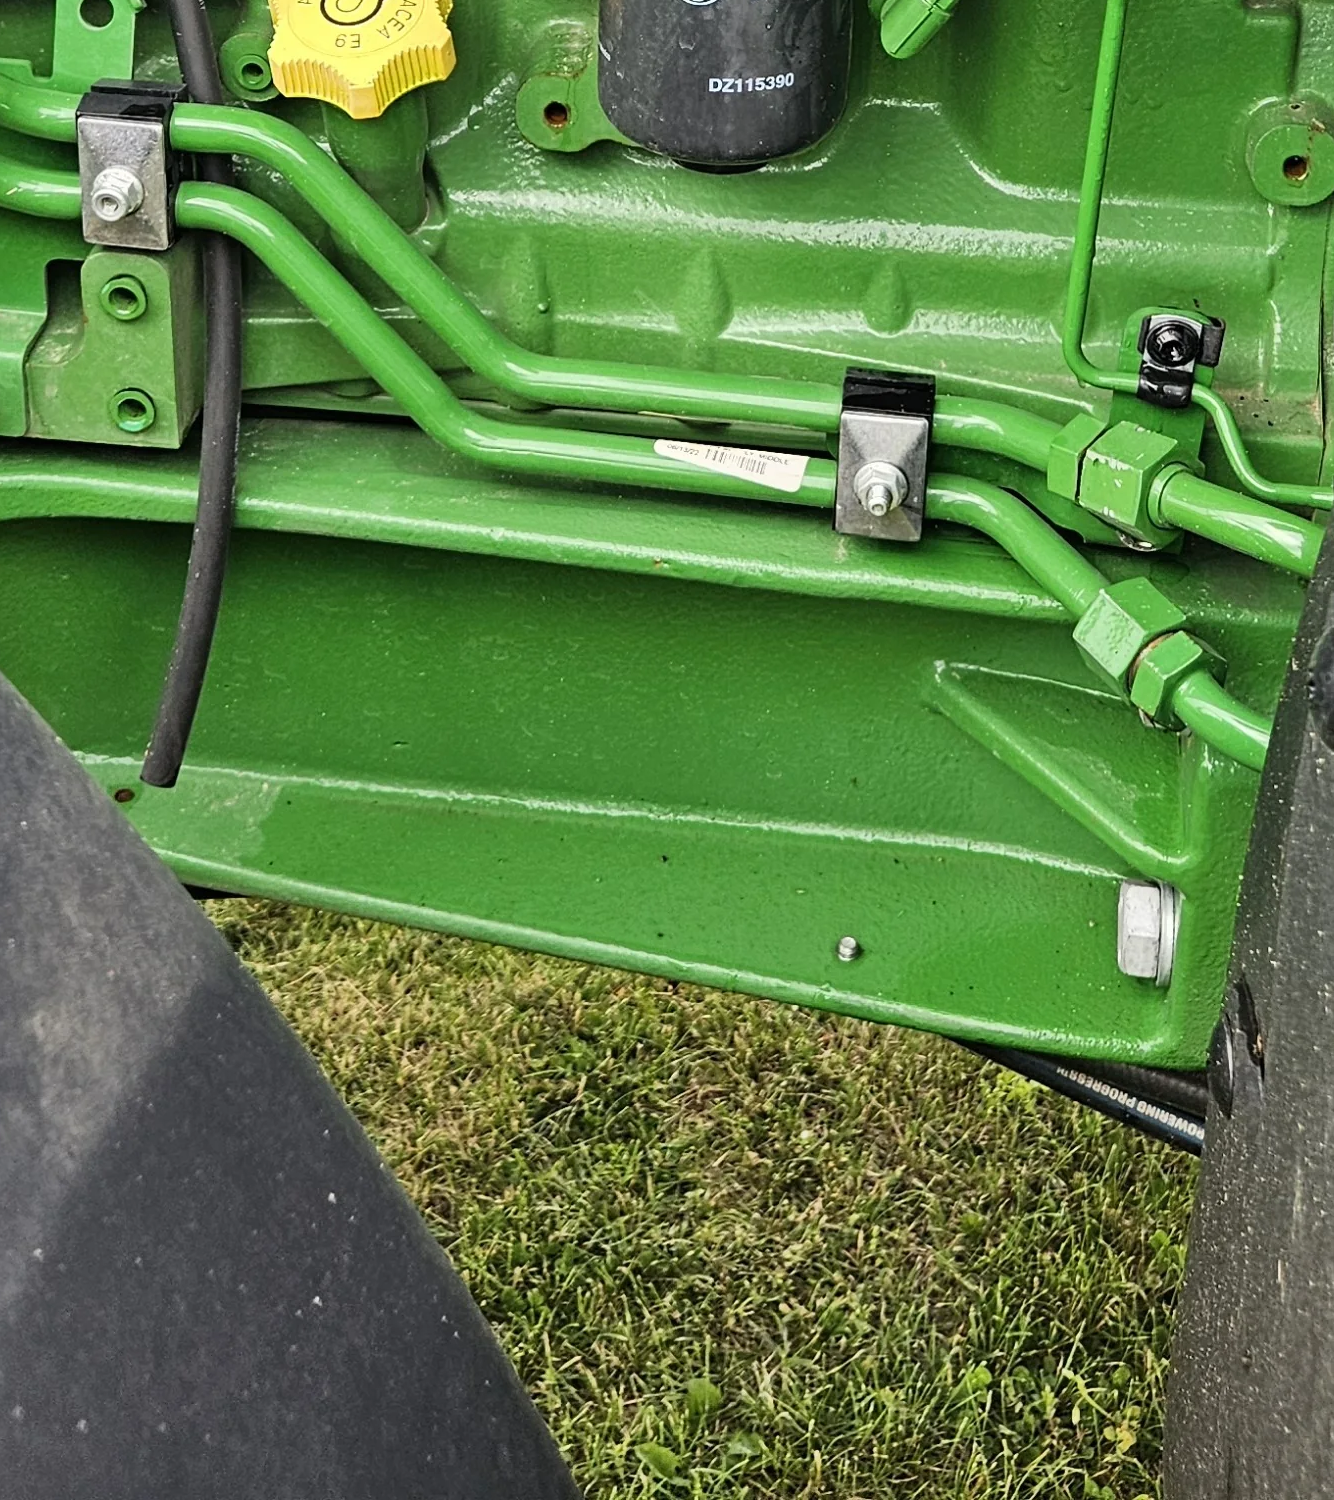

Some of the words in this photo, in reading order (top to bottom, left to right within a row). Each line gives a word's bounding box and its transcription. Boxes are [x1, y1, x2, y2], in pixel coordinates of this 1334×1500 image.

[334, 33, 361, 49] E9
[708, 72, 795, 93] DZ115390
[666, 443, 700, 457] 06/13/22
